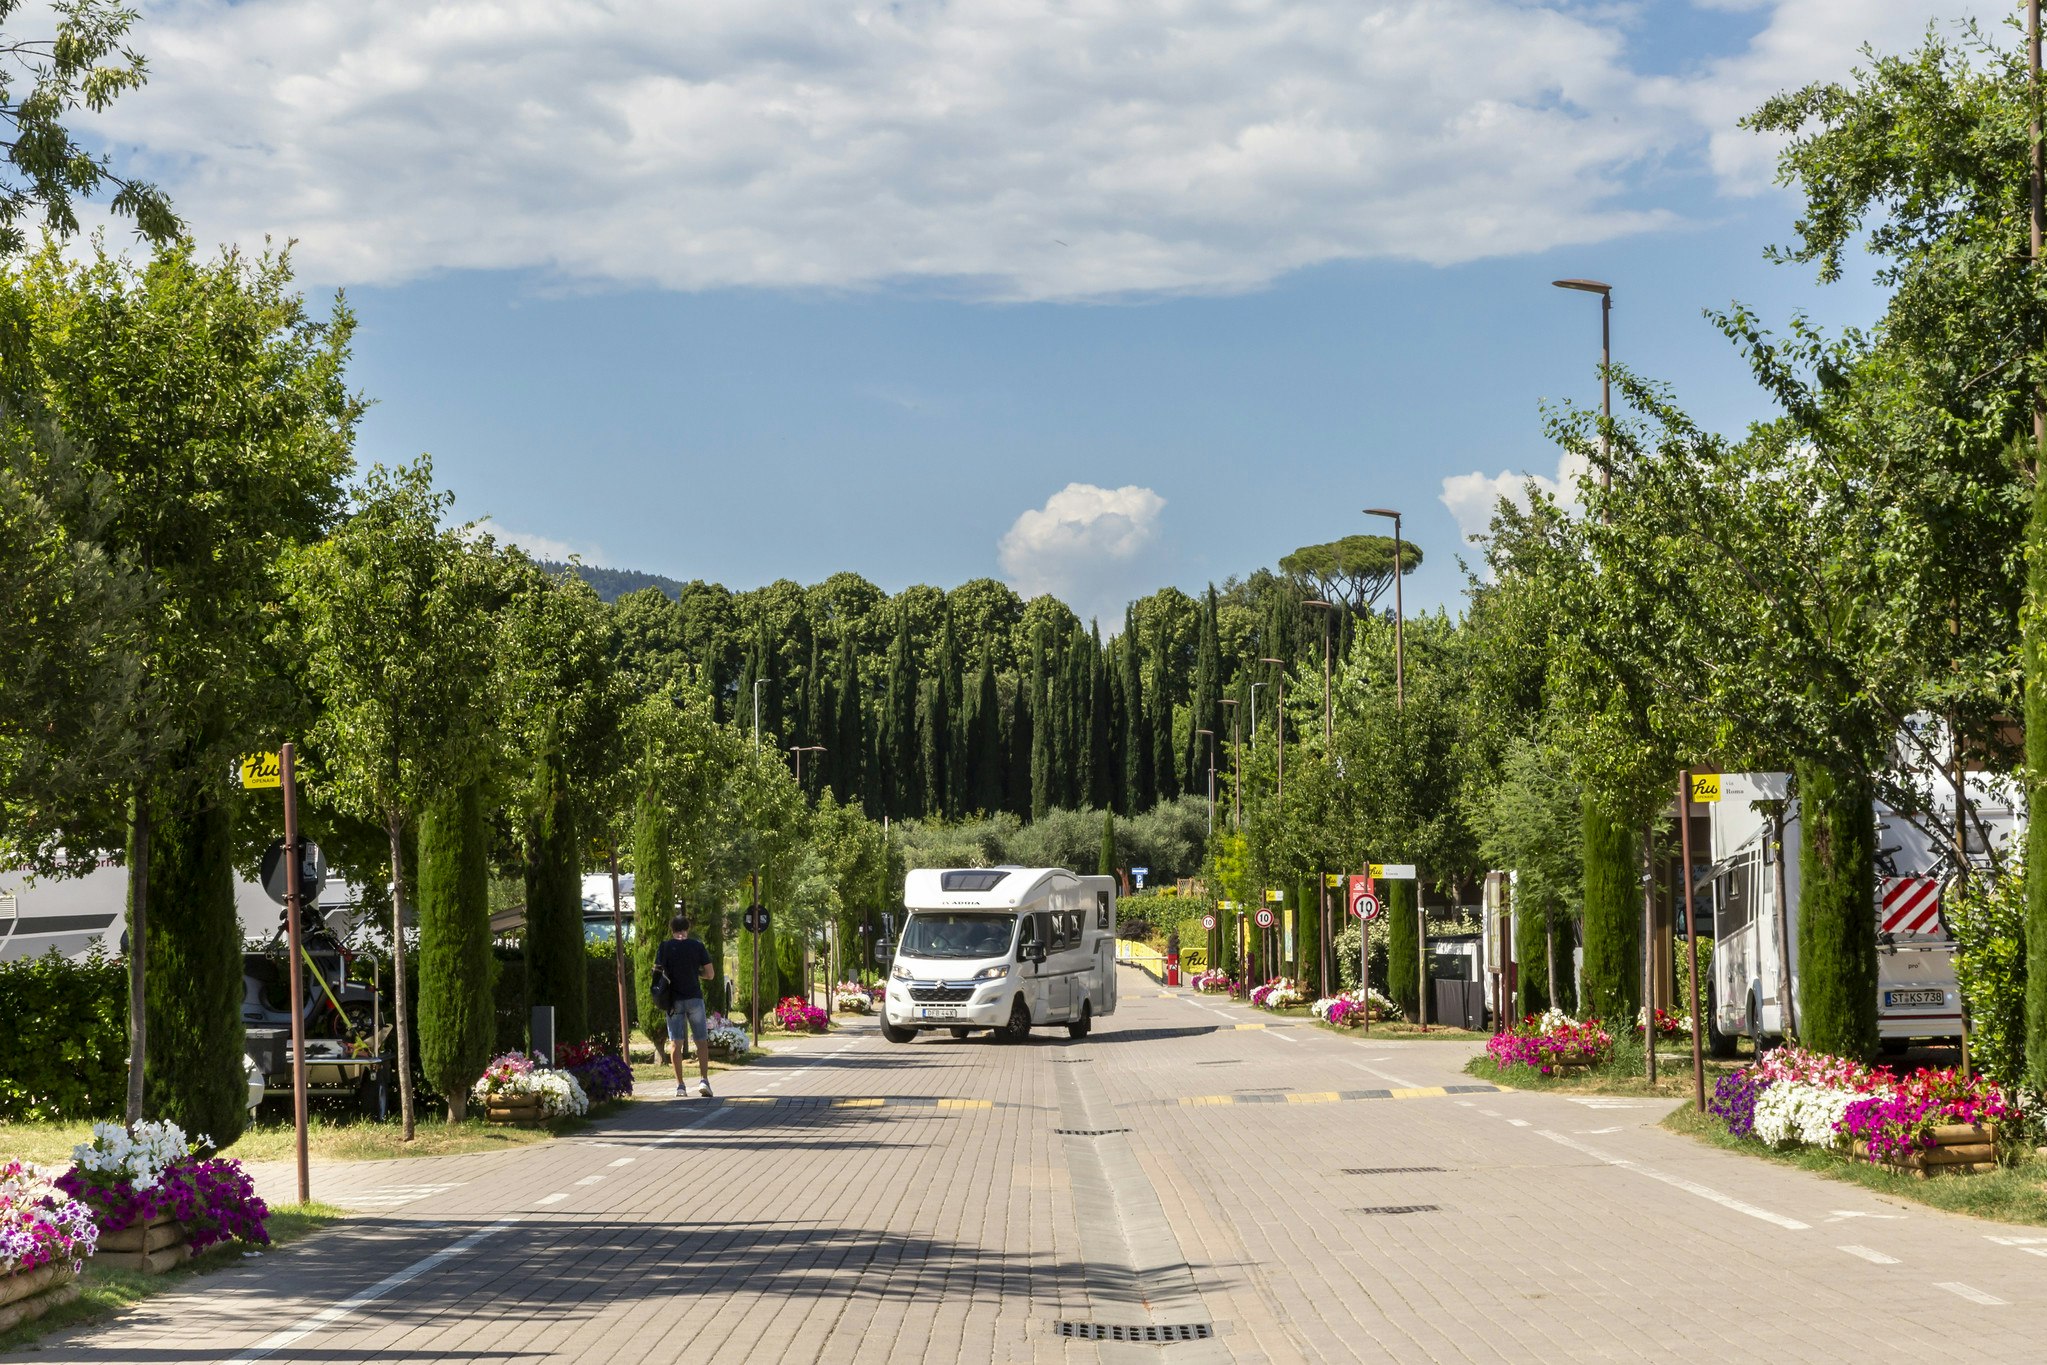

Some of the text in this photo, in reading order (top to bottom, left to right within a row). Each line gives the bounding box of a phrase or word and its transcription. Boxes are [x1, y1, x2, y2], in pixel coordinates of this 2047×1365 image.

[1692, 779, 1718, 795] hu
[1360, 901, 1373, 912] 10
[1260, 914, 1269, 922] 10
[1185, 951, 1207, 966] hu
